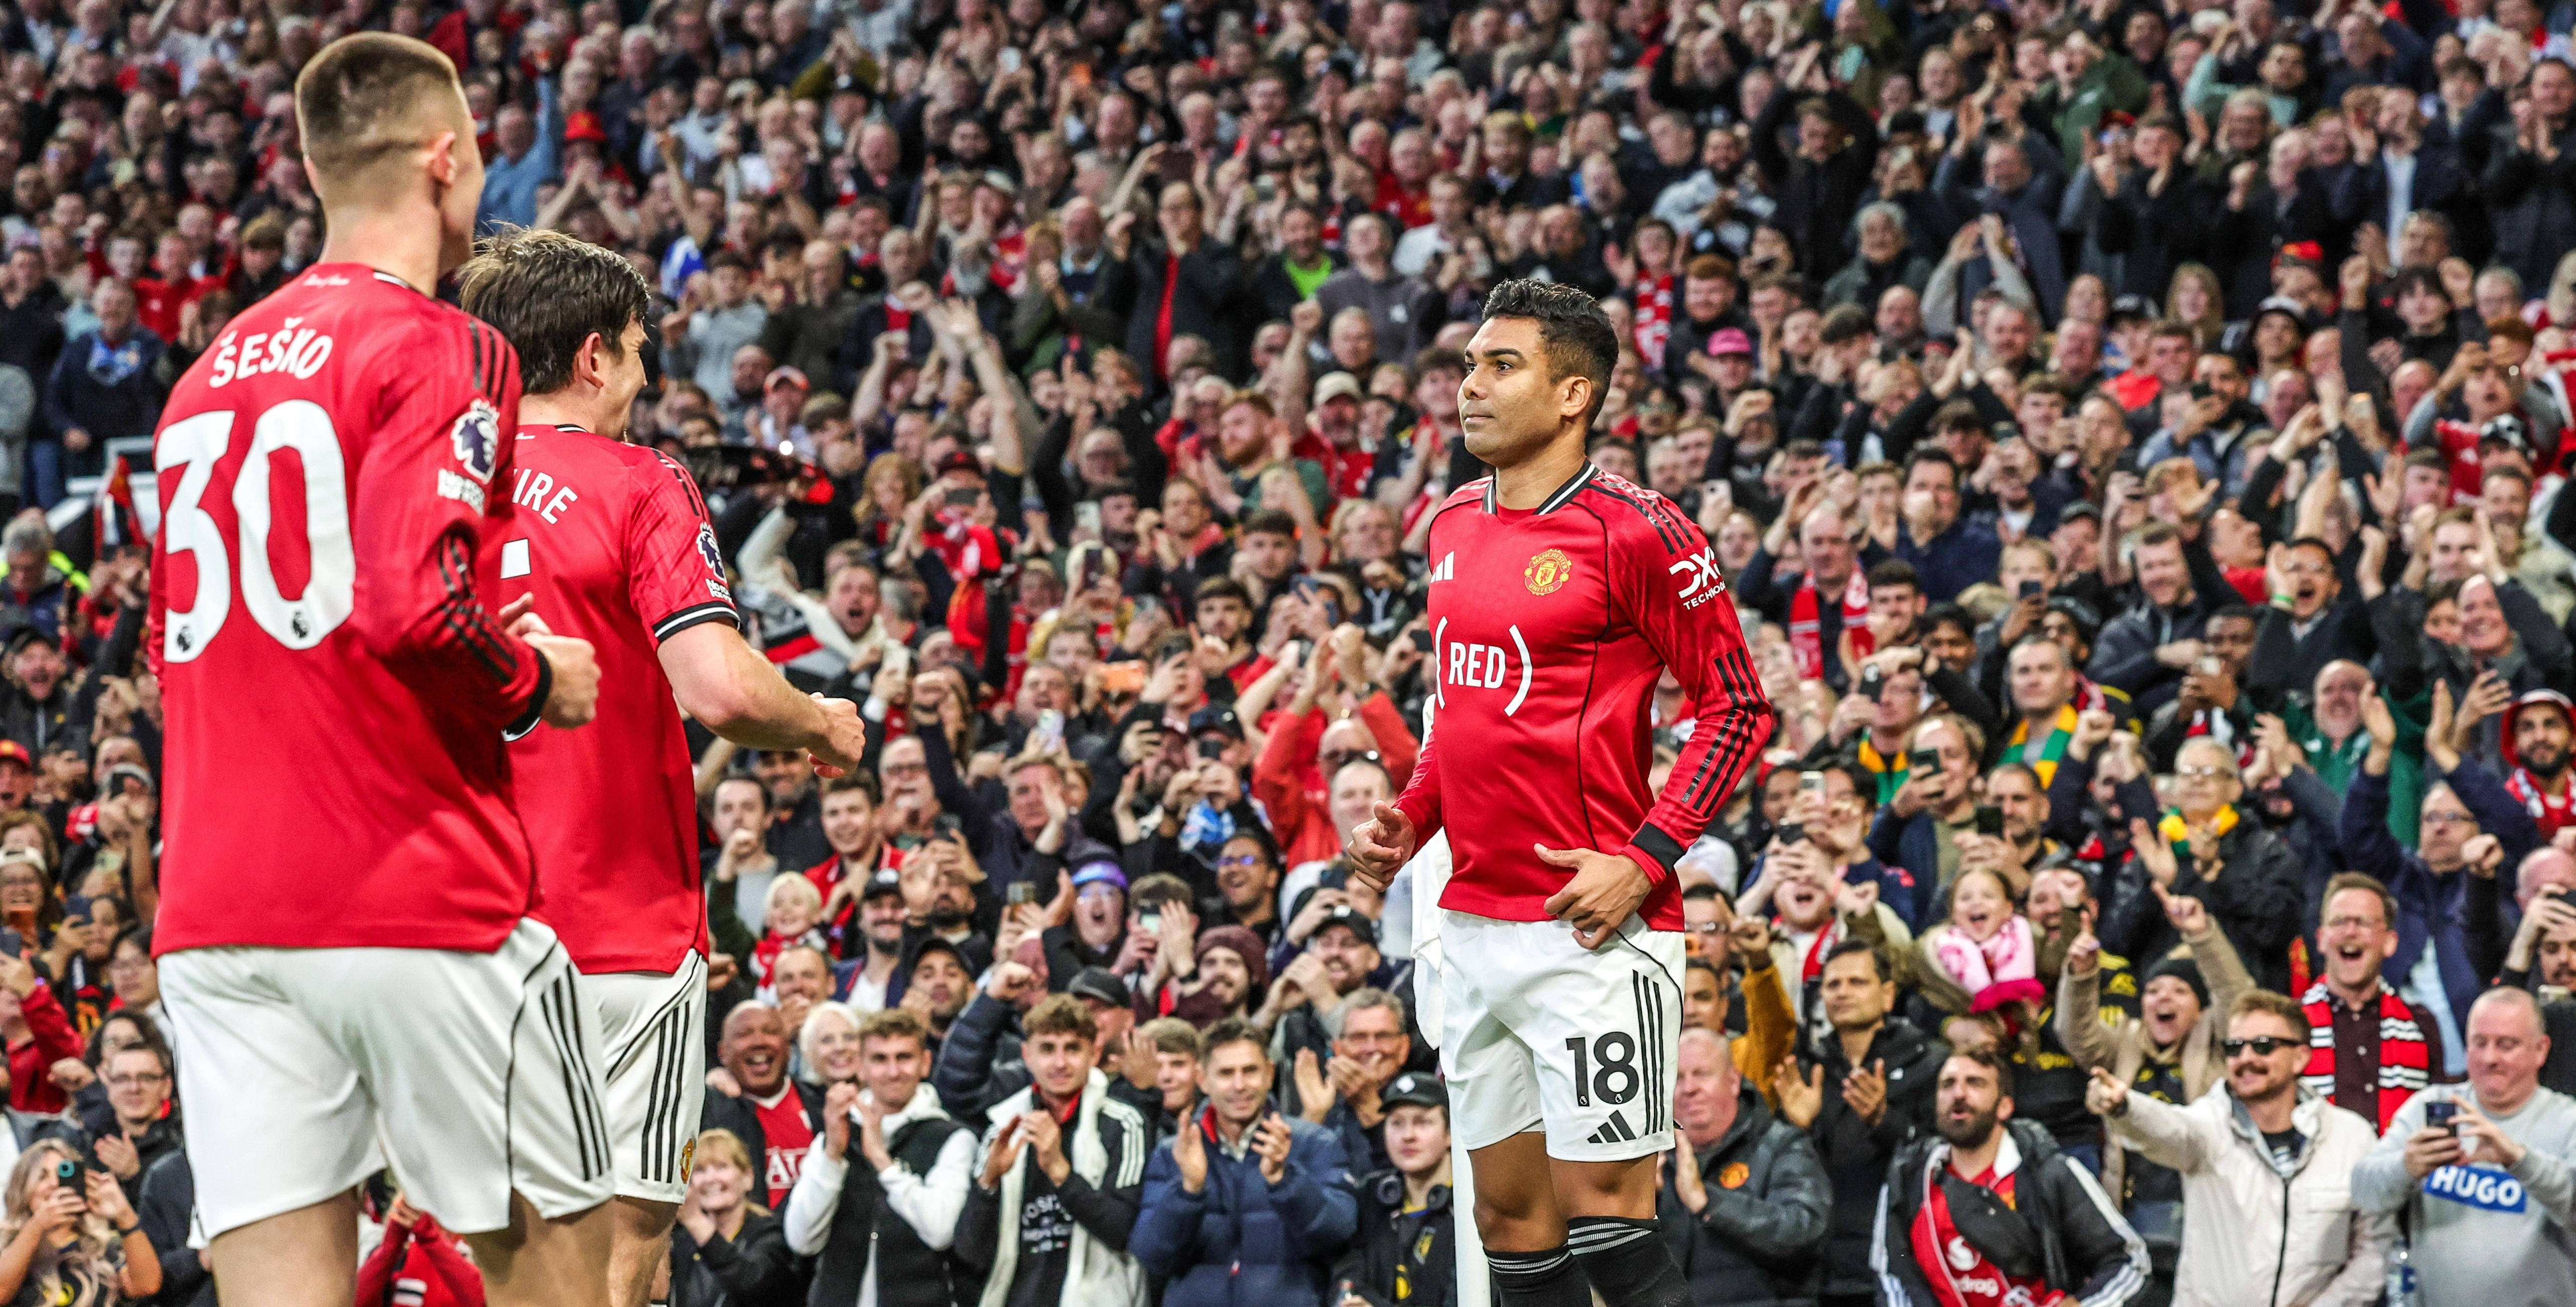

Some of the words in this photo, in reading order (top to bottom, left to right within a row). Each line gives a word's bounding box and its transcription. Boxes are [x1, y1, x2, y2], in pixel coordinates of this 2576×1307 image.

[512, 468, 578, 524] IRE
[156, 399, 356, 663] 30
[1532, 552, 1568, 569] MANCHESTER
[1529, 583, 1554, 592] UNITED
[1565, 1031, 1639, 1107] 18
[2430, 1164, 2522, 1207] HUGO
